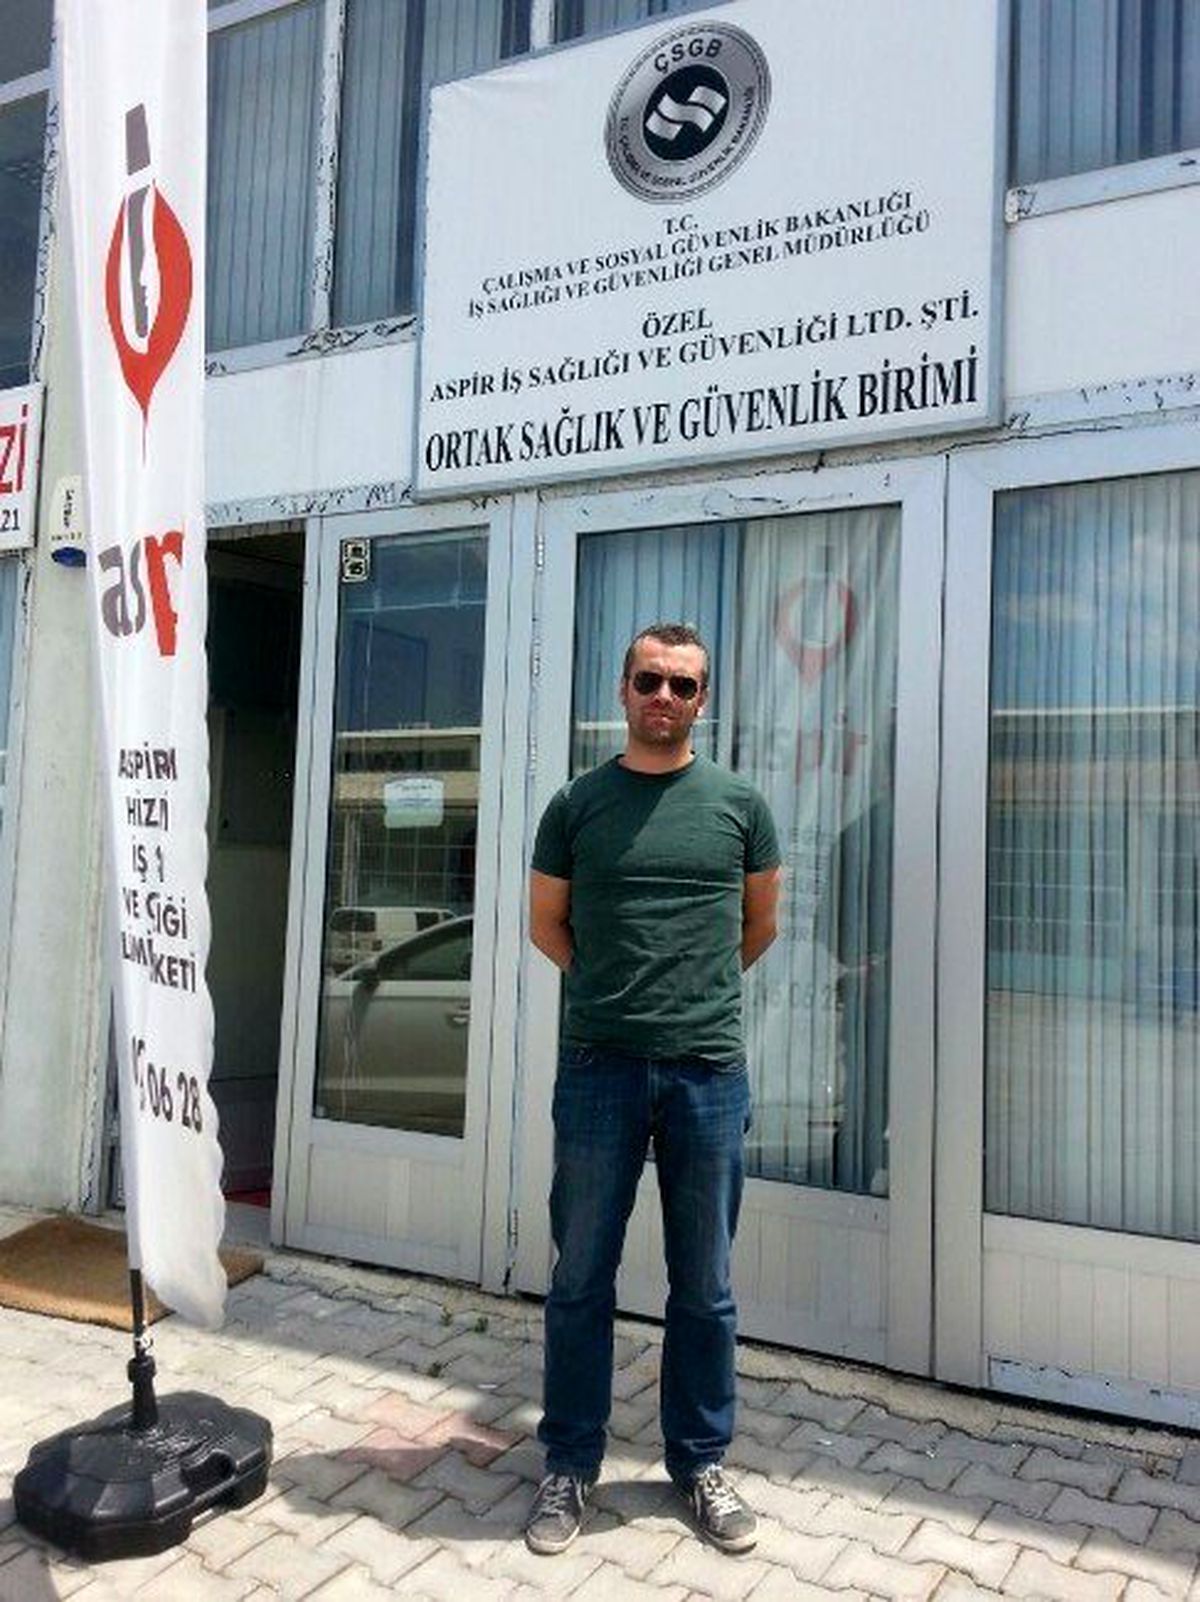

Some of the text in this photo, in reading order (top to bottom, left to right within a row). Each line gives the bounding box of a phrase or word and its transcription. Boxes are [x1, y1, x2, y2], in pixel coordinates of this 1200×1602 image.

[654, 38, 722, 74] ÇSGB
[469, 298, 484, 319] İŞ
[487, 285, 561, 314] SAĞLIĞI
[566, 280, 590, 300] VE
[708, 243, 780, 273] GENEL
[783, 209, 931, 257] MÜDÜRLÜĞÜ
[482, 189, 912, 295] ÇALIŞMA VE SOSYAL GÜVENLİK BAKANLIĞI
[663, 214, 698, 235] T.C.
[430, 289, 979, 402] ASPİR İŞ SAĞLIĞI VE GÜVENLİĞİ LTD. ŞTİ.
[643, 307, 713, 338] ÖZEL
[425, 345, 979, 472] ORTAK SAĞLIK VE GÜVENLİK BİRİMİ
